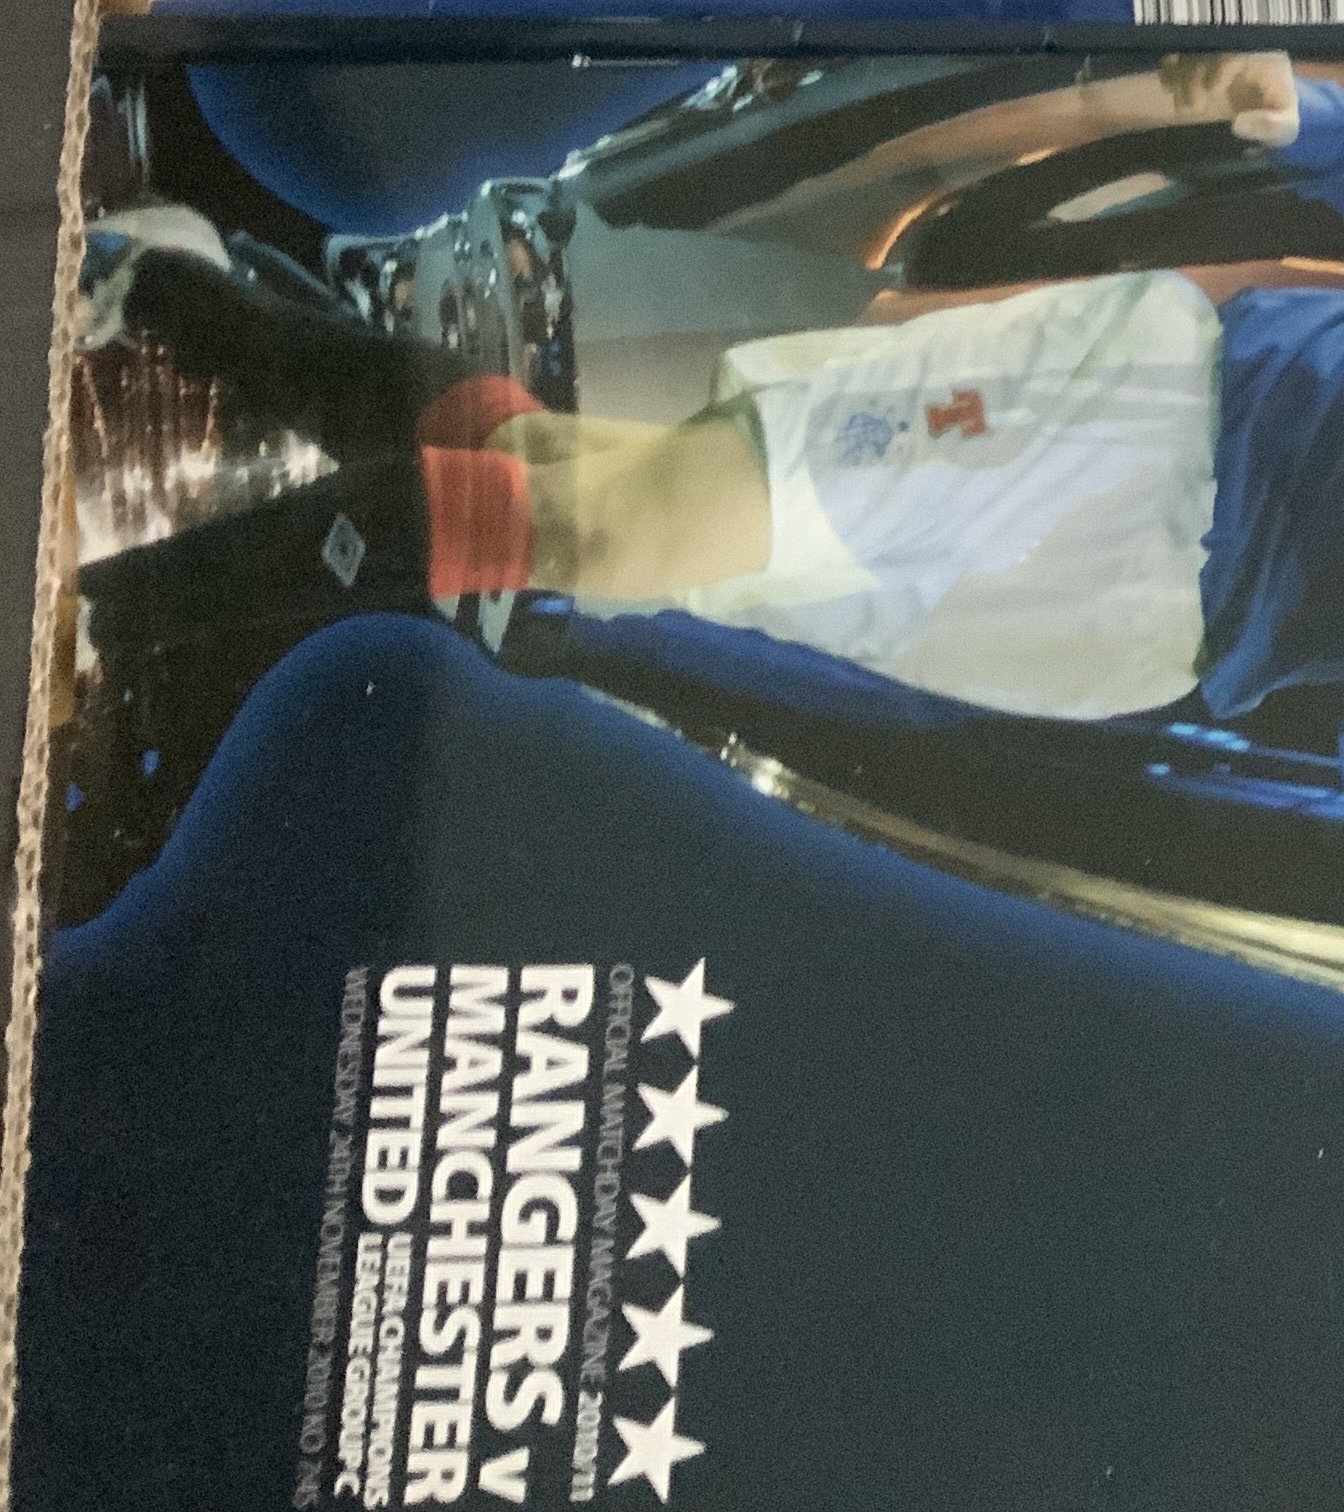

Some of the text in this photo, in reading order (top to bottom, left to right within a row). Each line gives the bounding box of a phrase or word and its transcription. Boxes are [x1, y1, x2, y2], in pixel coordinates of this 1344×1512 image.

[332, 967, 369, 1126] WEDNESDAY
[361, 964, 438, 1225] UNITED
[404, 964, 510, 1505] MANCHESTER
[485, 963, 596, 1430] RANGERS
[333, 1232, 384, 1499] LEAGUE GROUP C
[363, 1231, 414, 1511] UEFA CHAMPIONS
